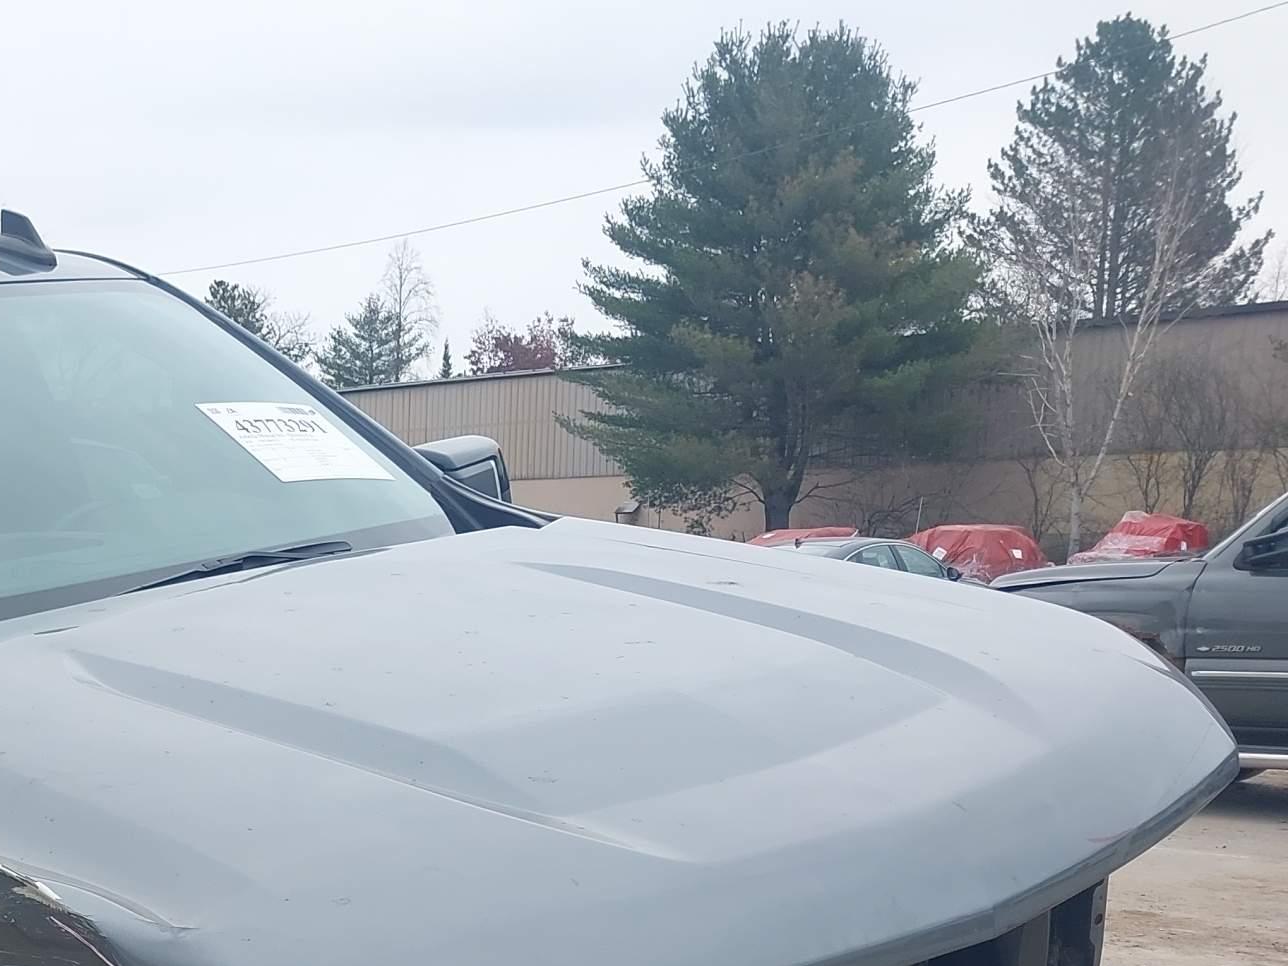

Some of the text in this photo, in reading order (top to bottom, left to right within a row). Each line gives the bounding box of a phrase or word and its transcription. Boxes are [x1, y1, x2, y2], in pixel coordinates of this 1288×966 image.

[234, 418, 328, 434] 43773291
[1211, 644, 1262, 653] 2500 HD
